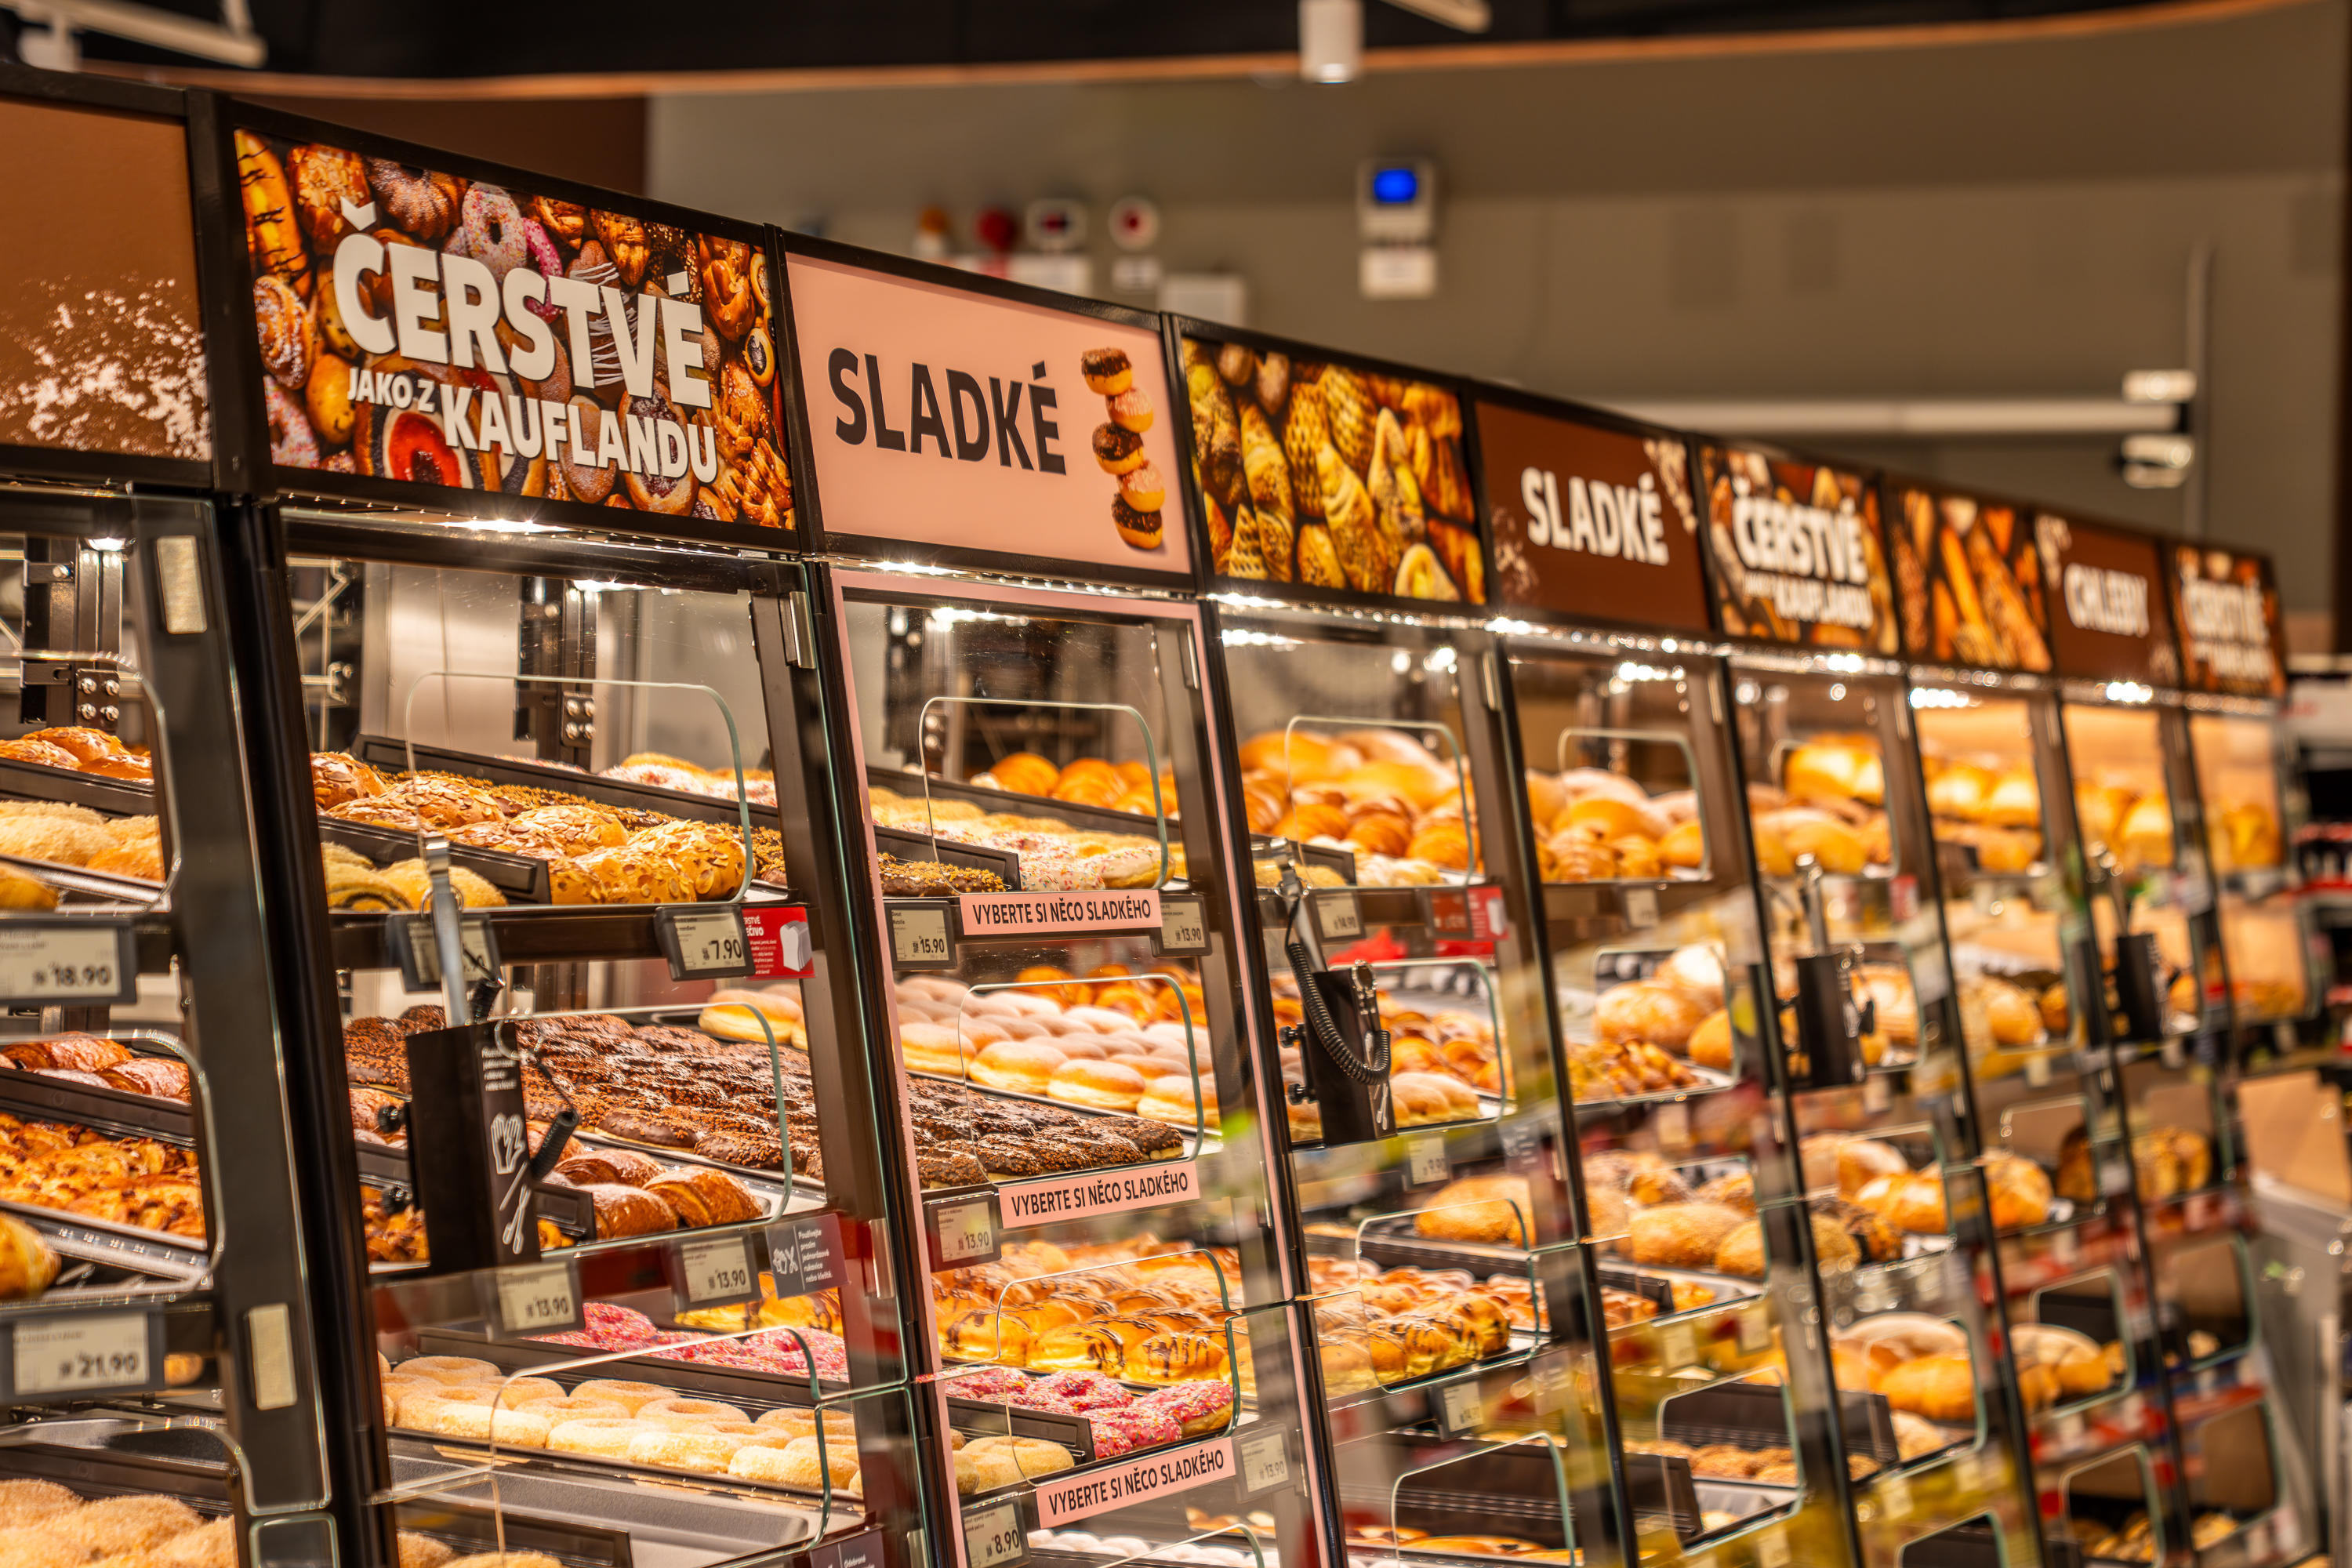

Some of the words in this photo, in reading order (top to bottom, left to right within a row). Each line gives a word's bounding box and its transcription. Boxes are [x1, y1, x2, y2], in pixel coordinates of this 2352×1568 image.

[333, 196, 711, 408] ČERSTVÉ
[828, 347, 1066, 475] SLADKÉ
[347, 367, 412, 408] JAKO
[417, 379, 435, 412] Z
[440, 383, 717, 484] KAUFLANDU
[1521, 466, 1669, 566] SLADKÉ
[1732, 477, 1868, 585] ČERSTVÉ
[743, 914, 761, 924] ERSTVÉ
[972, 902, 1033, 925] VYBERTE
[1036, 902, 1047, 923] SI
[1051, 897, 1083, 922] NĚCO
[1087, 895, 1151, 920] SLADKÉHO
[746, 925, 764, 937] EČIVO
[1181, 927, 1202, 942] 13.90
[711, 938, 742, 960] 7.90
[920, 938, 945, 953] 15.90
[51, 964, 111, 987] 18.90
[1011, 1189, 1072, 1217] VYBERTE
[1073, 1186, 1086, 1208] SI
[1088, 1180, 1121, 1206] NĚCO
[1125, 1170, 1189, 1200] SLADKÉHO
[798, 1229, 822, 1240] Používejte
[965, 1231, 989, 1250] 13.90
[800, 1241, 816, 1252] prosím
[804, 1262, 823, 1272] rukavice
[717, 1269, 746, 1289] 13.90
[535, 1296, 568, 1318] 13.90
[78, 1353, 139, 1377] 21.90
[1265, 1461, 1285, 1479] 13.90
[1049, 1481, 1109, 1515] VYBERTE
[1110, 1477, 1122, 1499] SI
[1124, 1467, 1158, 1495] NĚCO
[1160, 1449, 1224, 1485] SLADKÉHO
[994, 1529, 1019, 1554] 8.90
